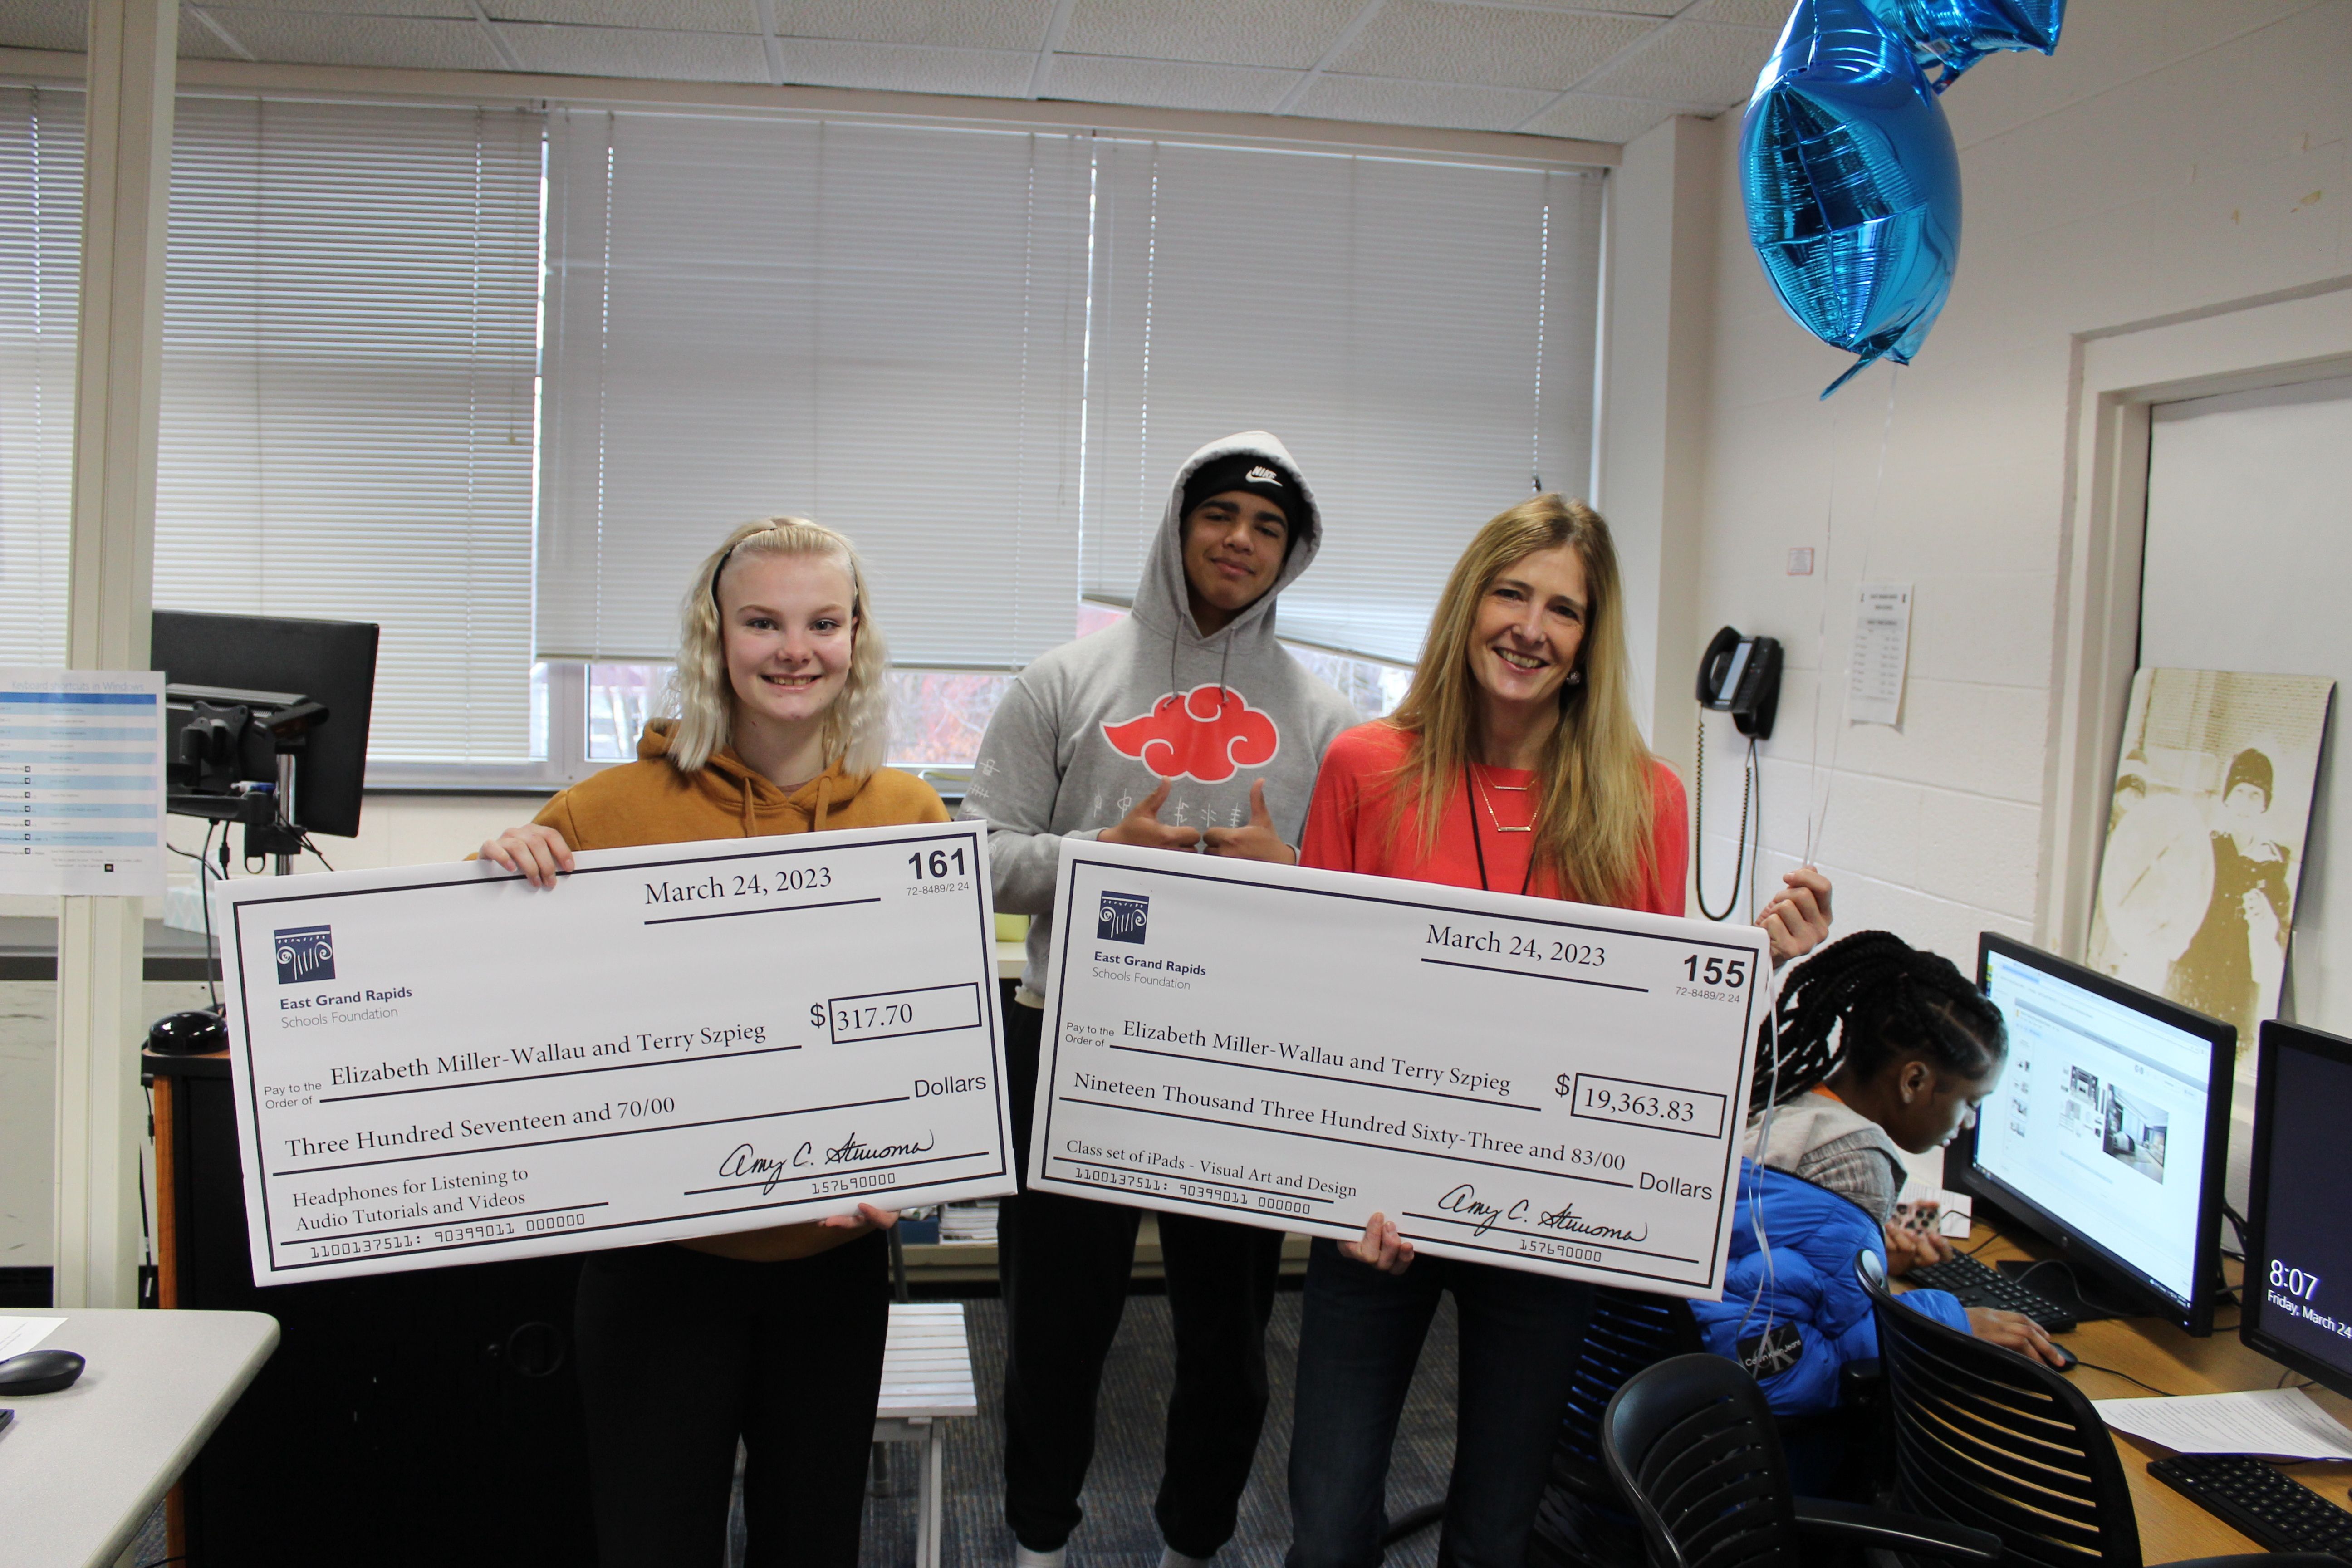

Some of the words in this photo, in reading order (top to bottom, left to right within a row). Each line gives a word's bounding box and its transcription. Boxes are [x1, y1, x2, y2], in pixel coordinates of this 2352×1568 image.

[1251, 466, 1277, 480] NIKE
[103, 681, 145, 692] Windows
[909, 848, 967, 880] 161
[645, 876, 725, 904] March
[734, 874, 768, 896] 24,
[776, 867, 831, 892] 2023
[958, 882, 969, 891] 24
[1426, 924, 1500, 953] March
[1509, 936, 1542, 961] 24,
[1550, 942, 1605, 966] 2023
[1094, 951, 1120, 964] East
[1124, 955, 1162, 970] Grand
[1166, 960, 1206, 975] Rapids
[1685, 955, 1745, 988] 155
[1092, 966, 1131, 982] Schools
[1134, 972, 1191, 990] Foundation
[280, 998, 311, 1010] East
[316, 991, 361, 1006] Grand
[366, 987, 412, 1003] Rapids
[1728, 994, 1740, 1003] 24
[281, 1013, 328, 1029] Schools
[332, 1009, 398, 1023] Foundation
[810, 1002, 826, 1029] $
[838, 1004, 912, 1031] 317.70
[1067, 1022, 1084, 1034] Pay
[1087, 1025, 1097, 1034] to
[1100, 1027, 1114, 1036] the
[1065, 1034, 1093, 1045] Order
[331, 1058, 429, 1085] Elizabeth
[438, 1043, 585, 1073] Miller-Wallau
[593, 1035, 631, 1056] and
[637, 1034, 693, 1052] Terry
[701, 1024, 766, 1047] Szpieg
[1123, 1020, 1205, 1046] Elizabeth
[1213, 1033, 1343, 1066] Miller-Wallau
[1350, 1056, 1384, 1072] and
[1392, 1058, 1444, 1086] Terry
[1449, 1068, 1510, 1096] Szpieg
[264, 1086, 285, 1096] Pay
[289, 1084, 300, 1093] to
[304, 1082, 322, 1091] the
[915, 1076, 986, 1098] Dollars
[1555, 1073, 1570, 1098] $
[1586, 1088, 1693, 1122] 19,363.83
[265, 1098, 298, 1109] Order
[302, 1095, 312, 1105] of
[285, 1137, 349, 1156] Three
[357, 1121, 454, 1149] Hundred
[461, 1114, 566, 1137] Seventeen
[573, 1102, 611, 1124] and
[617, 1098, 675, 1118] 70/00
[1074, 1072, 1155, 1098] Nineteen
[1162, 1085, 1254, 1113] Thousand
[1261, 1100, 1314, 1122] Three
[1321, 1109, 1406, 1136] Hundred
[1412, 1123, 1523, 1154] Sixty-Three
[1529, 1145, 1565, 1161] and
[1571, 1149, 1625, 1170] 83/00
[1067, 1140, 1102, 1156] Class
[1106, 1150, 1124, 1160] set
[1129, 1150, 1145, 1163] of
[1148, 1152, 1184, 1169] iPads
[1200, 1160, 1244, 1179] Visual
[1249, 1169, 1271, 1183] Art
[1276, 1174, 1303, 1188] and
[1308, 1177, 1356, 1199] Design
[293, 1186, 398, 1210] Headphones
[403, 1179, 426, 1194] for
[432, 1172, 508, 1187] Listening
[512, 1170, 528, 1181] to
[1640, 1172, 1712, 1200] Dollars
[297, 1213, 348, 1231] Audio
[352, 1202, 428, 1224] Tutorials
[433, 1197, 463, 1214] and
[468, 1192, 525, 1209] Videos
[2269, 1259, 2319, 1300] 8:07
[2267, 1289, 2300, 1316] Friday,
[2302, 1305, 2336, 1332] March
